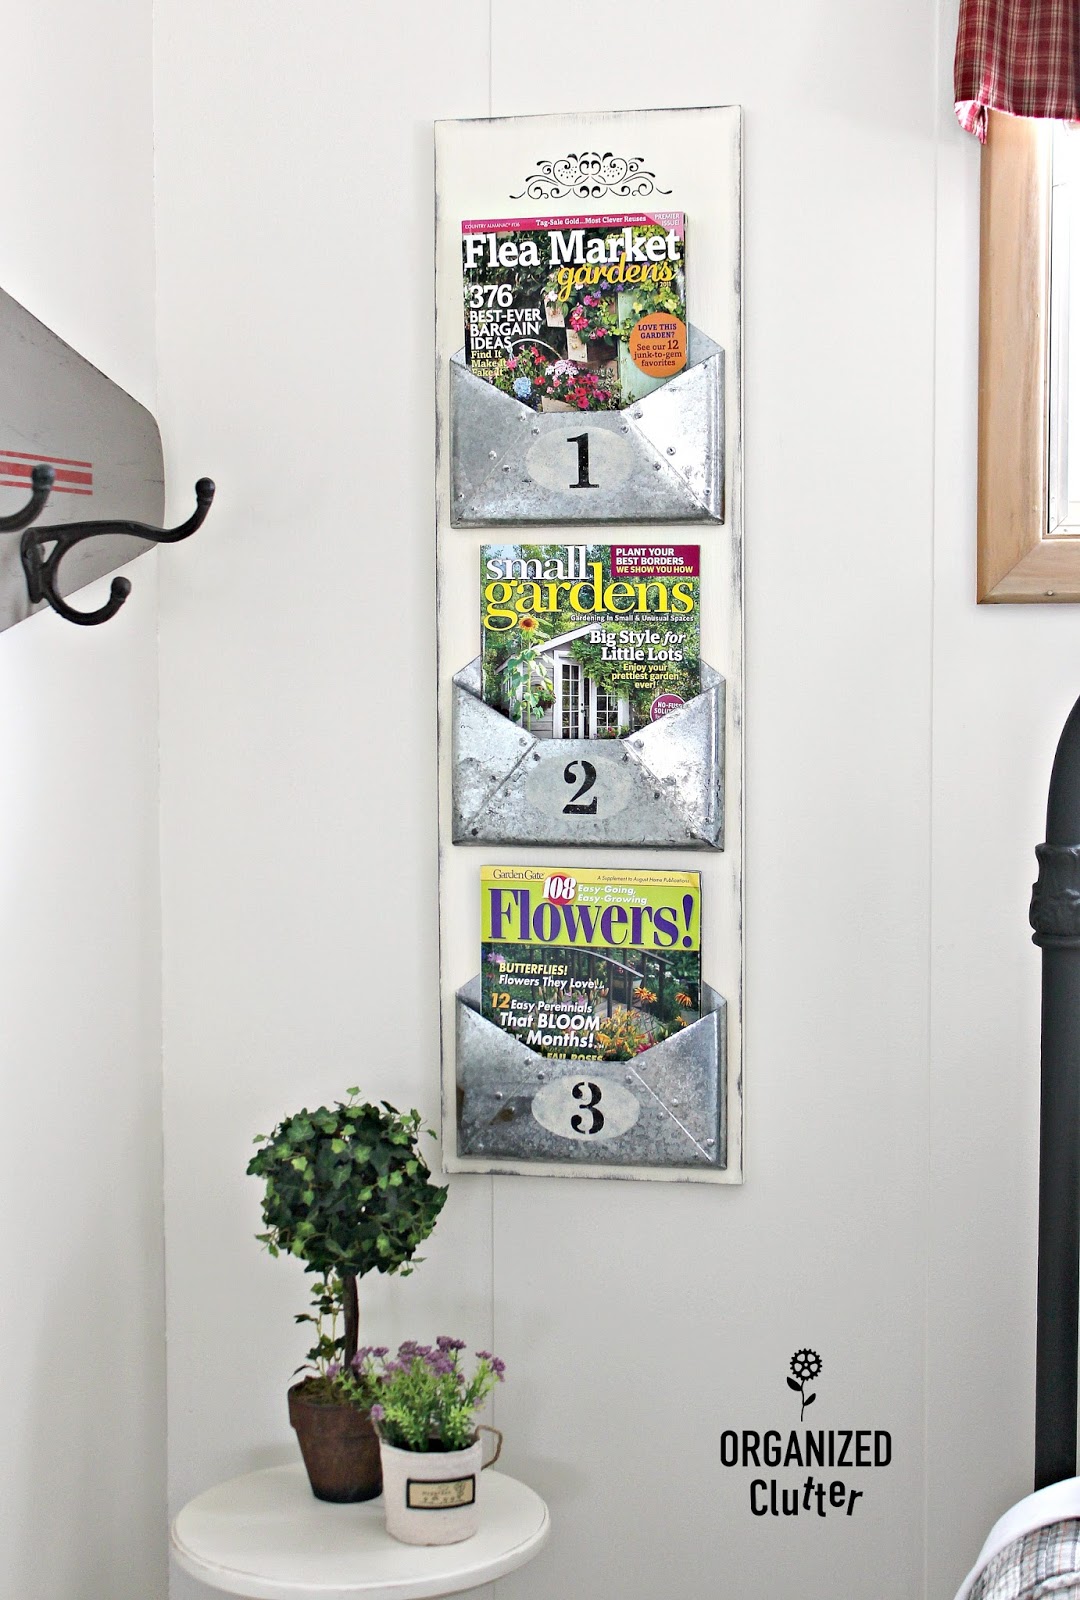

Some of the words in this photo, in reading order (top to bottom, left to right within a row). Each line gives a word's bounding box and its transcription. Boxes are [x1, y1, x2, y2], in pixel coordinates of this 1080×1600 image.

[536, 219, 563, 227] Tag-Sale
[602, 216, 624, 224] Clever
[624, 215, 647, 223] Reuses
[462, 233, 541, 269] Flea
[547, 226, 682, 266] Market
[557, 251, 678, 303] gardens
[469, 284, 514, 309] 376
[469, 308, 543, 323] BEST-EVER
[470, 321, 540, 337] BARGAIN
[637, 323, 658, 331] LOVE
[659, 323, 677, 331] THIS
[640, 331, 675, 339] GARDEN?
[470, 336, 512, 350] IDEAS
[636, 343, 651, 351] See
[667, 339, 679, 350] 12
[471, 350, 492, 359] Find
[494, 349, 502, 358] It
[633, 351, 682, 360] junk-to-gem
[471, 359, 497, 368] Make
[641, 359, 676, 367] favorites
[566, 432, 600, 489] 1
[615, 548, 647, 556] PLANT
[648, 548, 675, 556] YOUR
[486, 545, 590, 580] small
[615, 557, 640, 565] BEST
[640, 557, 684, 566] BORDERS
[483, 561, 695, 632] gardens
[570, 614, 605, 622] Gardening
[670, 615, 694, 623] Spaces
[589, 630, 617, 647] Big
[619, 629, 660, 647] Style
[661, 631, 686, 646] for
[601, 647, 645, 661] Little
[647, 647, 683, 661] Lots
[623, 663, 647, 673] Enjoy
[648, 664, 668, 673] your
[611, 672, 648, 682] prettiest
[649, 672, 679, 682] garden
[634, 681, 656, 689] ever!
[562, 760, 598, 815] 2
[492, 869, 524, 880] Garden
[524, 870, 545, 880] Gate
[542, 876, 577, 900] 108
[577, 884, 637, 896] Easy-Going,
[577, 894, 648, 906] Easy-Growing
[487, 888, 694, 948] Flowers!
[499, 962, 568, 976] BUTTERFLIES!
[498, 974, 540, 986] Flowers
[542, 976, 568, 989] They
[491, 992, 511, 1009] 12
[511, 999, 536, 1013] Easy
[537, 1001, 593, 1014] Perennials
[500, 1012, 534, 1028] That
[537, 1013, 600, 1031] BLOOM
[570, 1081, 605, 1135] 3
